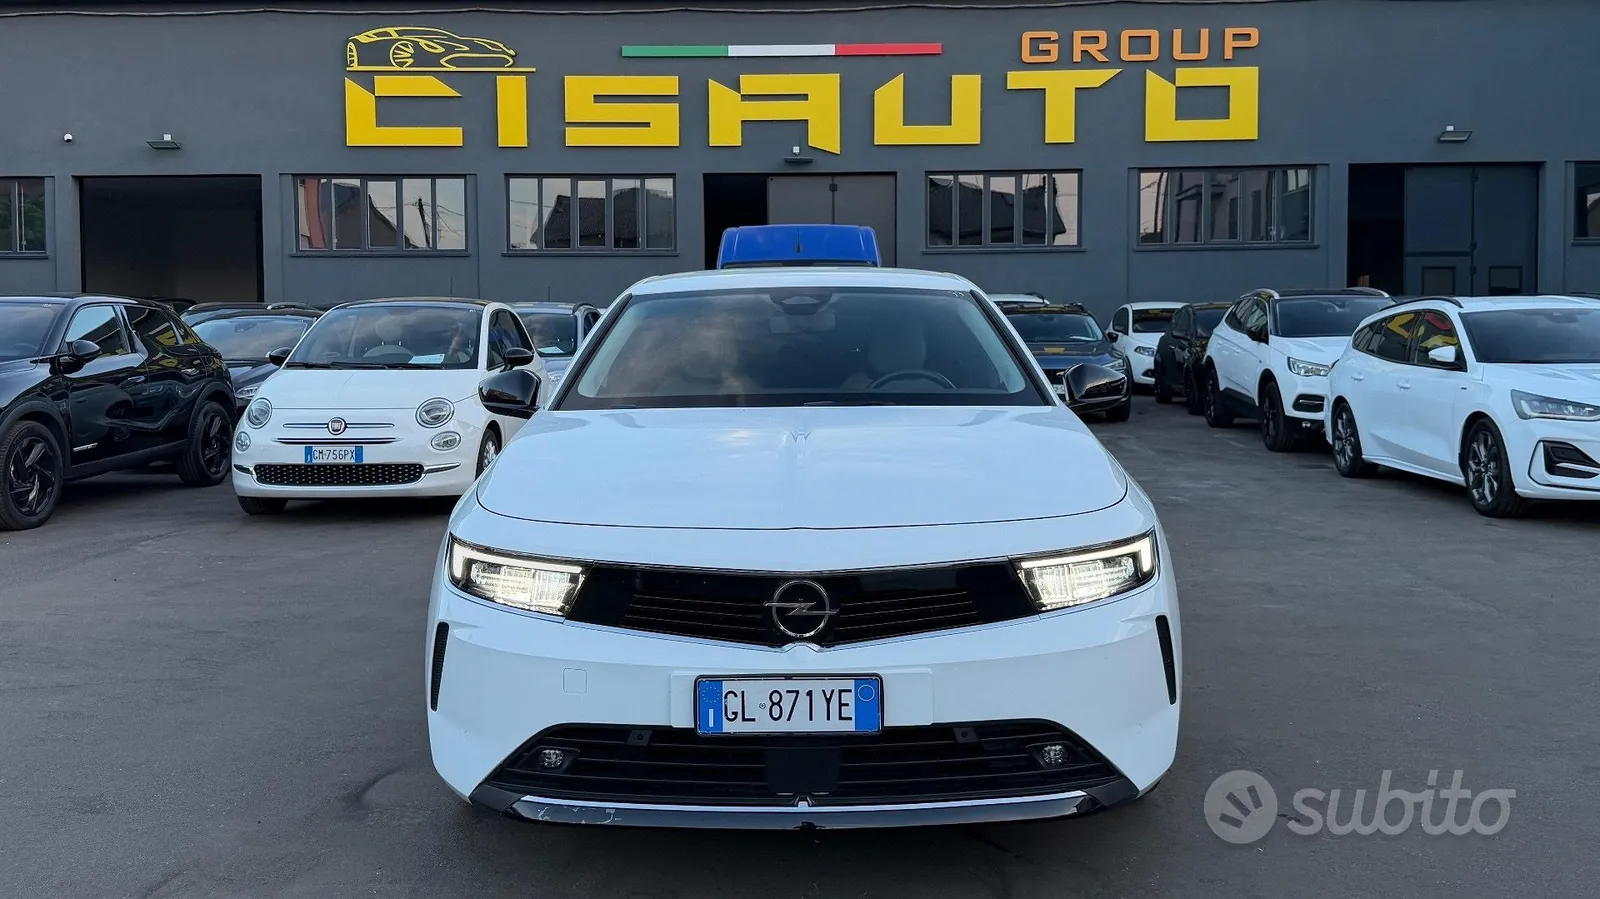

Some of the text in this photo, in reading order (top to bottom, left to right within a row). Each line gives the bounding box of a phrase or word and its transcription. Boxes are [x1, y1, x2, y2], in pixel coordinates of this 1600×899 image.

[1020, 27, 1260, 63] GROUP
[345, 66, 1259, 154] CISAUTO
[724, 689, 853, 722] GL 871YE
